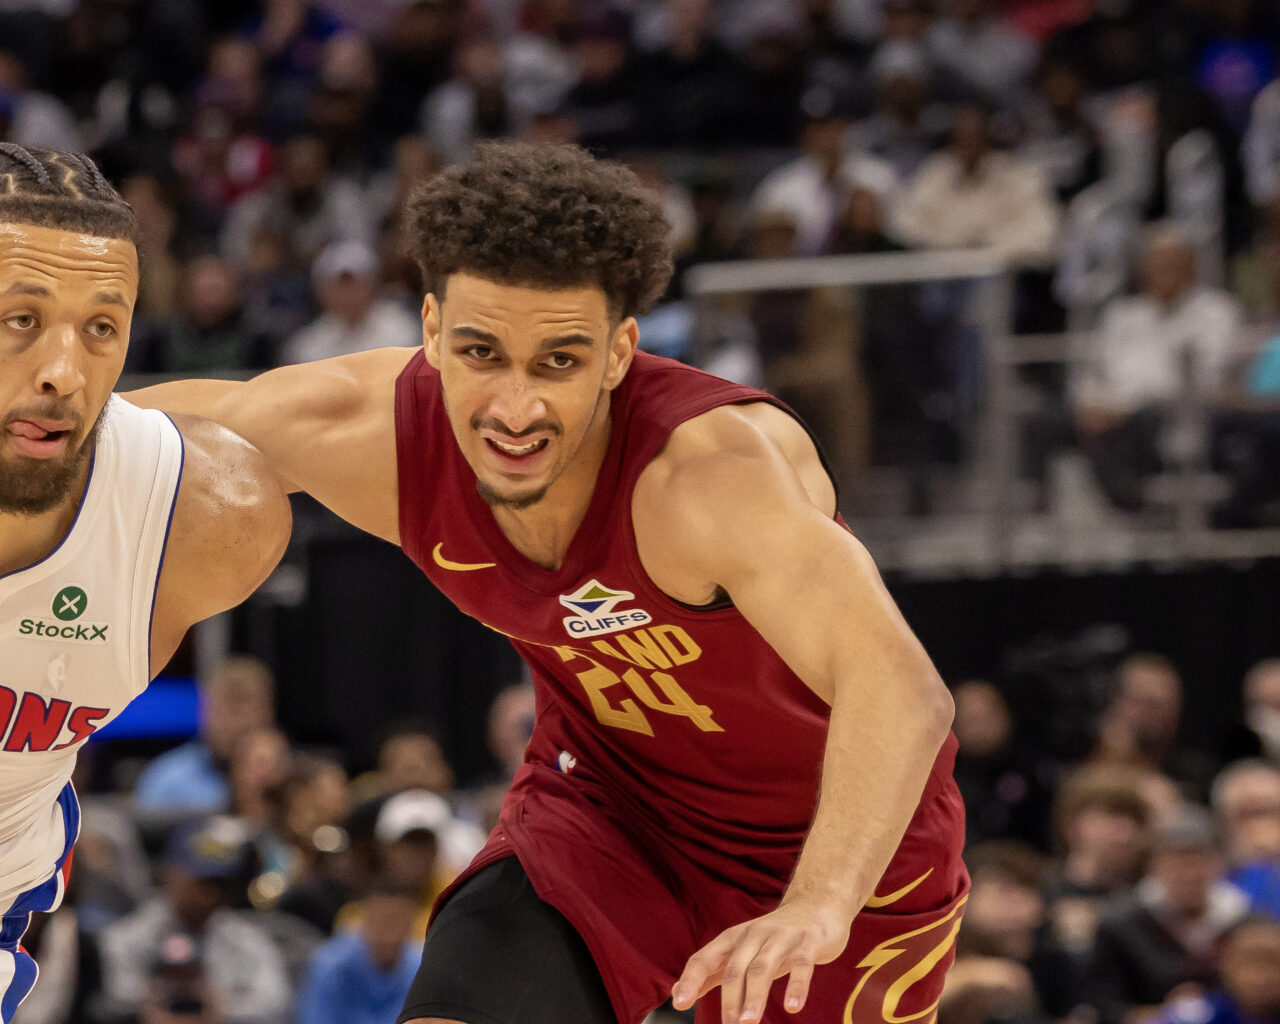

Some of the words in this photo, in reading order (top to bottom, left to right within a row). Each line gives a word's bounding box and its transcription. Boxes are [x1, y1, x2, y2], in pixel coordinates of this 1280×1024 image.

[18, 618, 109, 642] StockX
[568, 611, 648, 633] CLIFFS
[554, 645, 726, 738] 24
